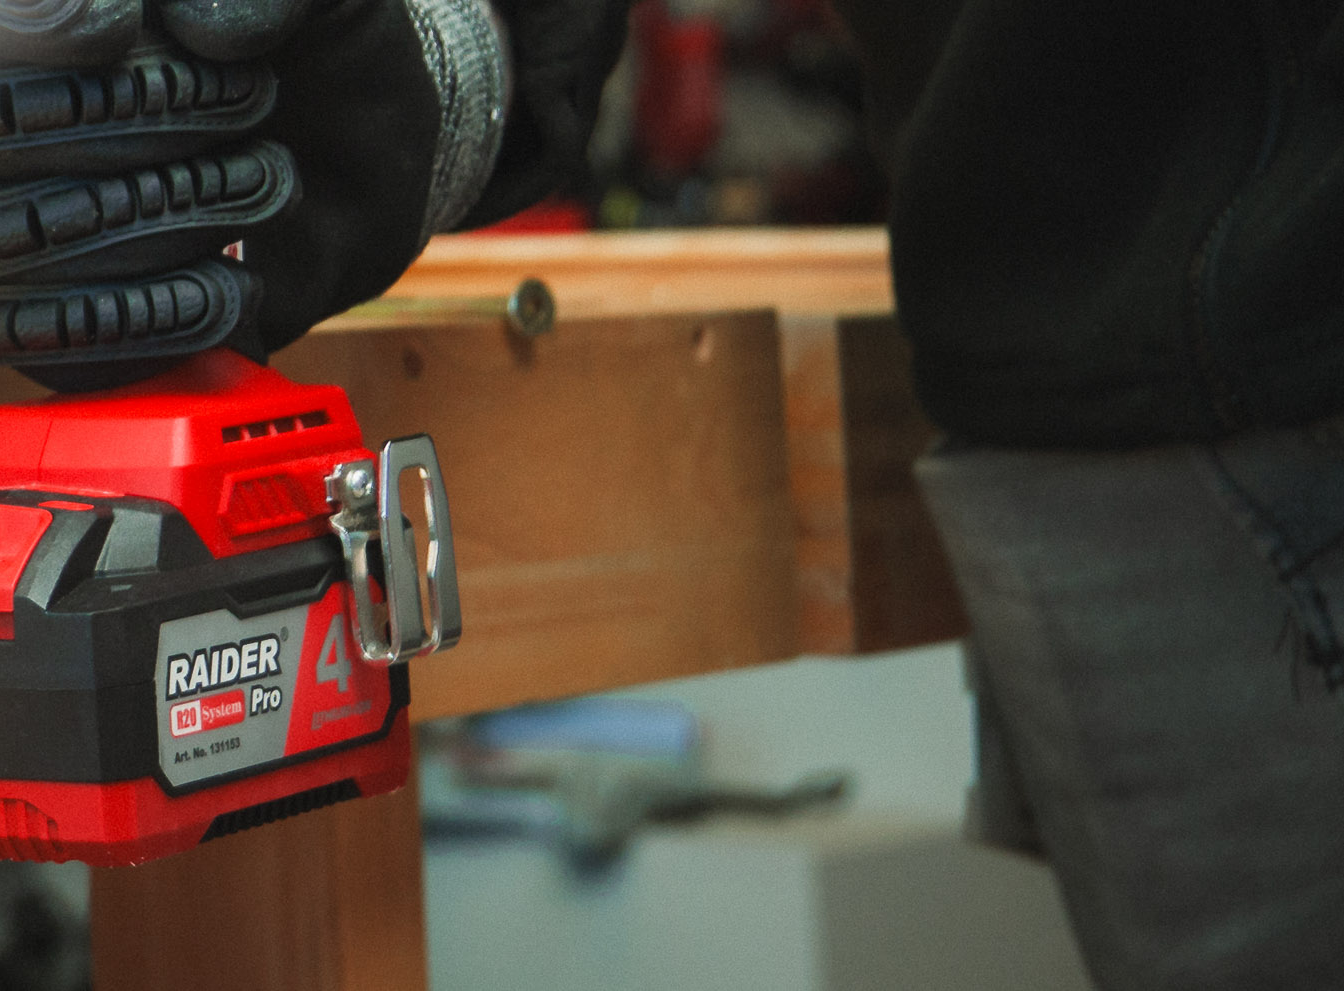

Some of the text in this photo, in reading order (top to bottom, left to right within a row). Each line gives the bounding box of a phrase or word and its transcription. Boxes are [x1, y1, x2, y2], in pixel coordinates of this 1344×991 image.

[167, 634, 282, 699] RAIDER
[177, 700, 242, 730] R20 System
[251, 685, 283, 716] Pro
[174, 750, 191, 764] Art.
[193, 744, 207, 758] No.
